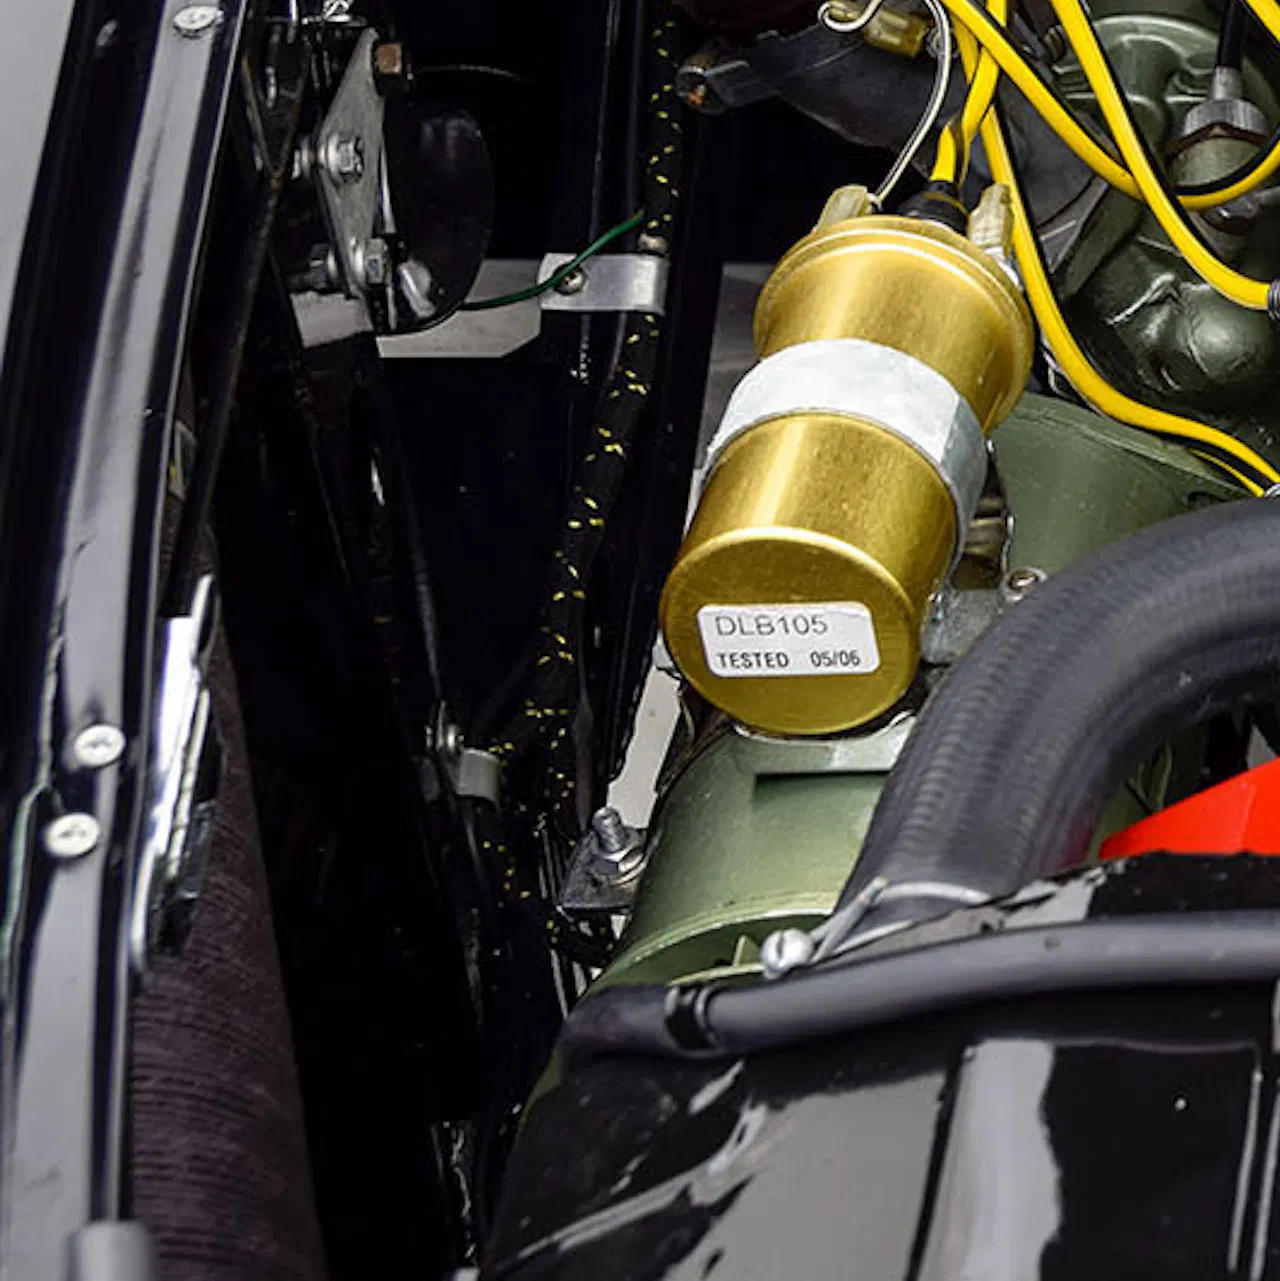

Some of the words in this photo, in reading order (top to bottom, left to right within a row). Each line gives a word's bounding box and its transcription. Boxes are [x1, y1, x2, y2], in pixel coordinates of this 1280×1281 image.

[715, 615, 829, 636] DLB105
[717, 652, 790, 669] TESTED
[809, 649, 862, 668] 05/06
